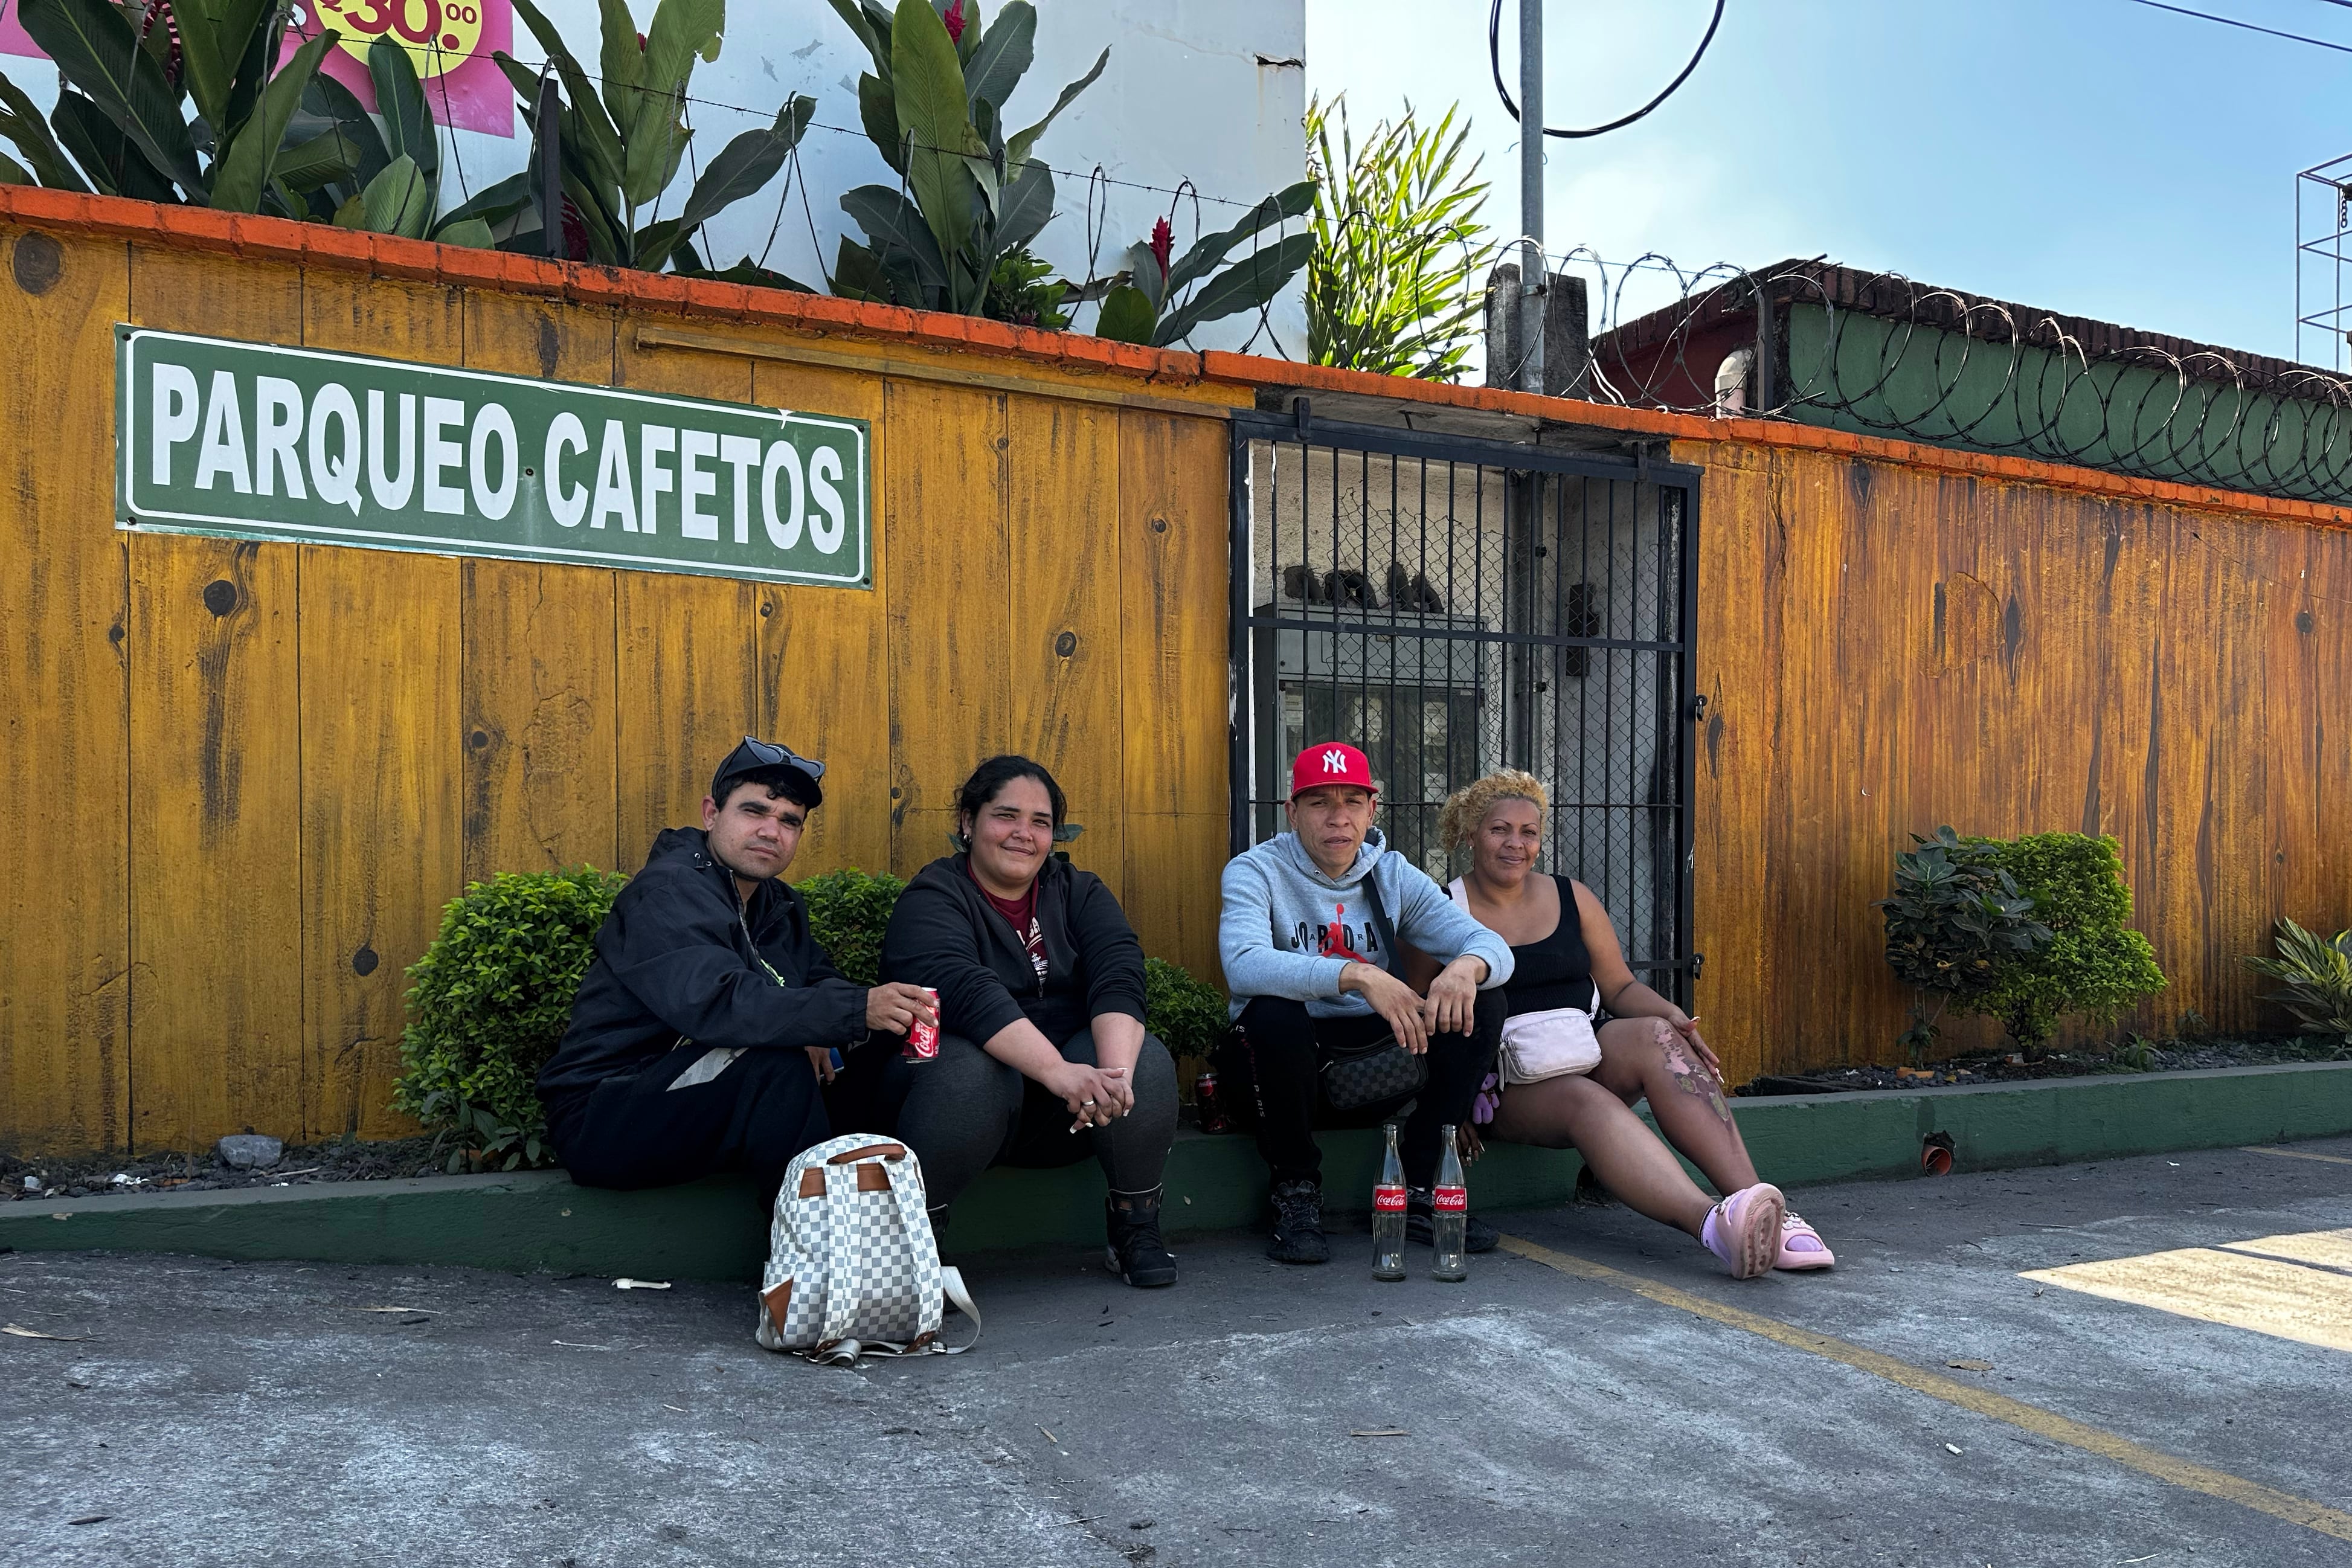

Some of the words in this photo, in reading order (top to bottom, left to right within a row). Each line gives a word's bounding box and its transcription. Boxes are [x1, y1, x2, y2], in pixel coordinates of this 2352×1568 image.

[153, 362, 518, 520] PARQUEO
[544, 412, 845, 554] CAFETOS
[1322, 750, 1347, 773] NY
[1291, 919, 1378, 953] JORDA
